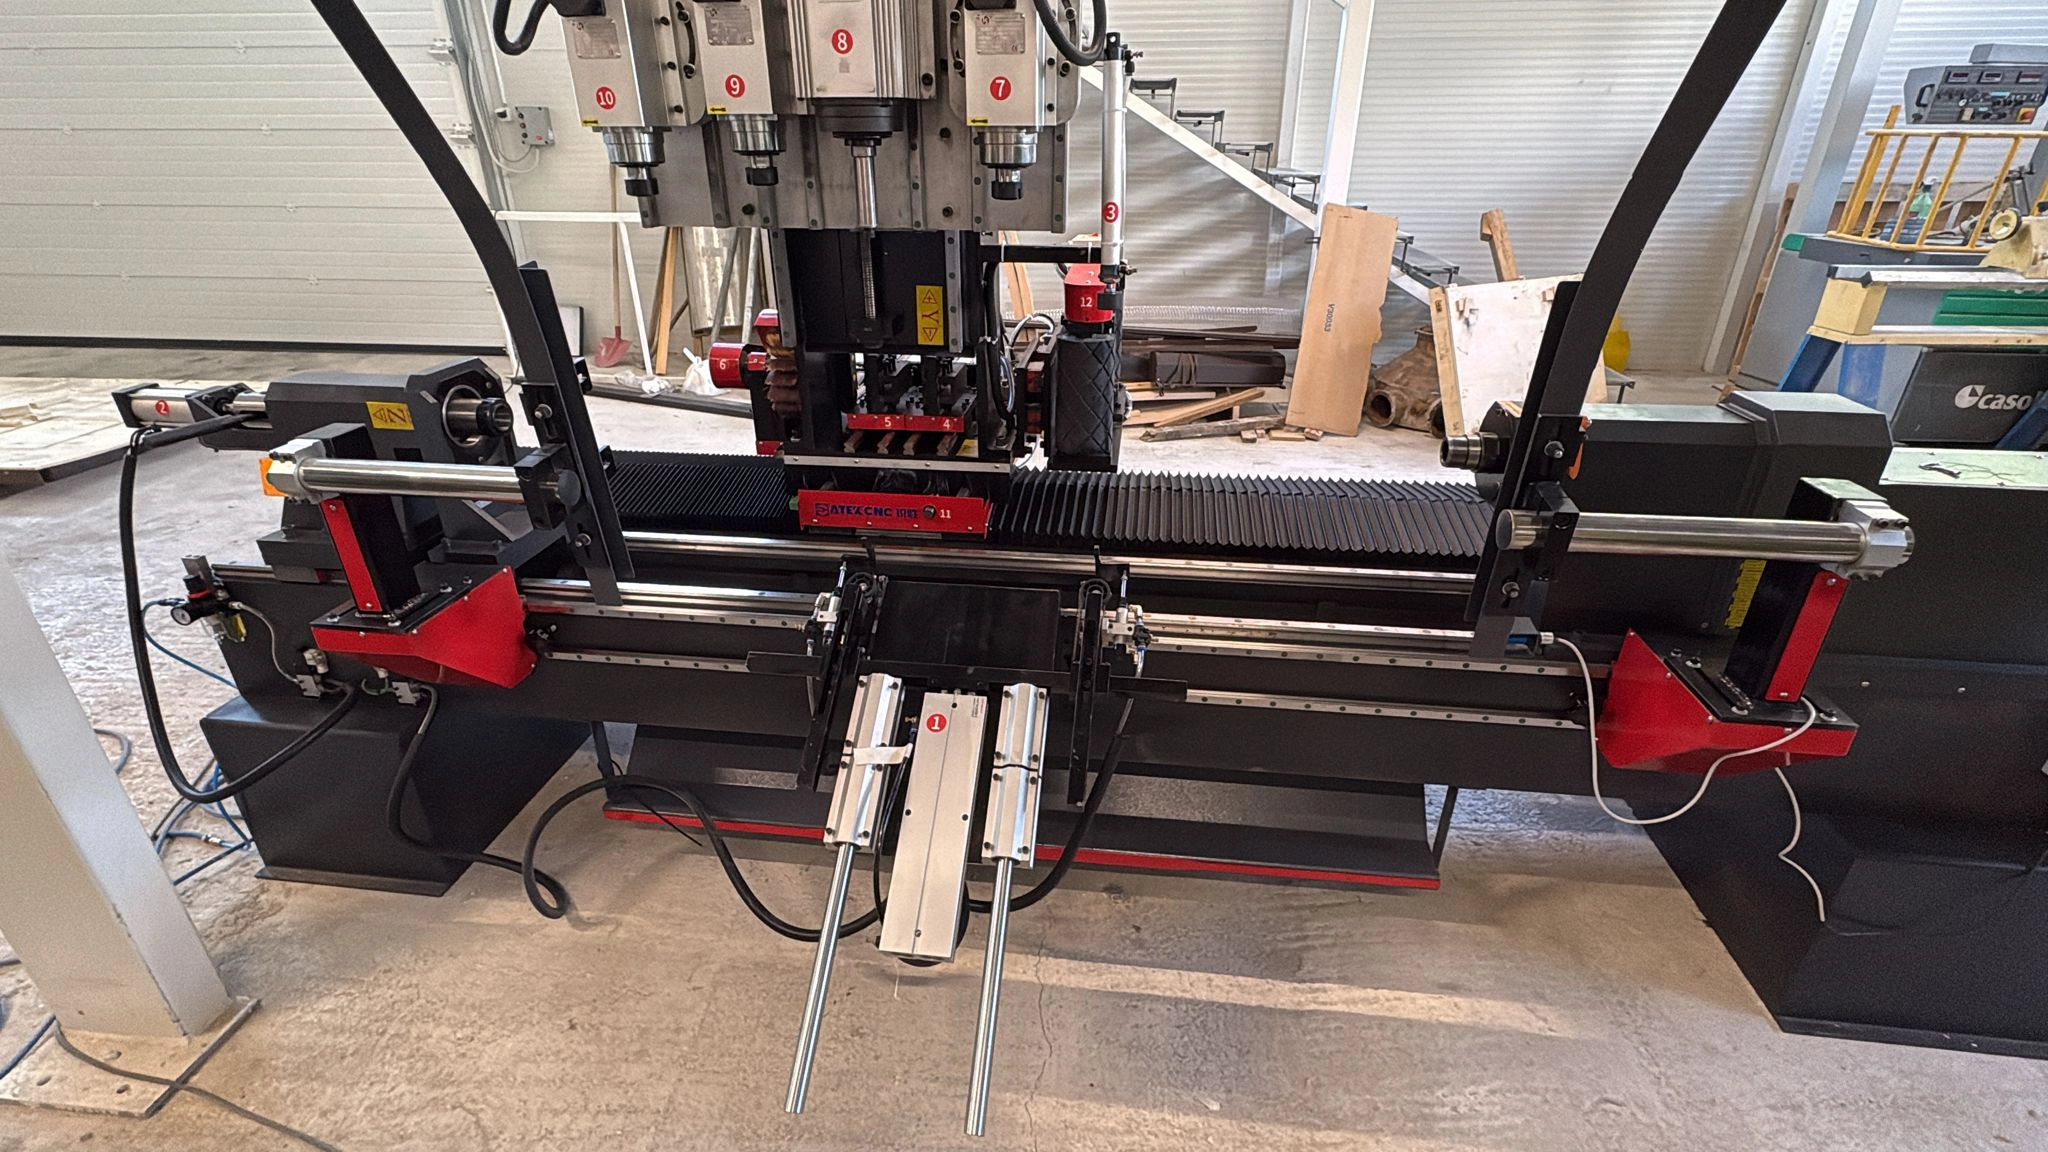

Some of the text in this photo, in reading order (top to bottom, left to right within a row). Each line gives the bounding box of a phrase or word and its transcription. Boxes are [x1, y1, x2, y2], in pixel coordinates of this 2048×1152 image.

[837, 31, 848, 51] 8
[730, 77, 740, 95] 9
[995, 79, 1006, 97] 7
[598, 90, 614, 106] 10
[1106, 204, 1116, 220] 3
[1080, 296, 1093, 308] 12
[719, 358, 727, 370] 6
[158, 401, 168, 414] 2
[884, 416, 892, 428] 5
[942, 418, 951, 430] 4
[863, 506, 894, 518] CNC
[939, 509, 952, 519] 11
[930, 715, 941, 731] 1
